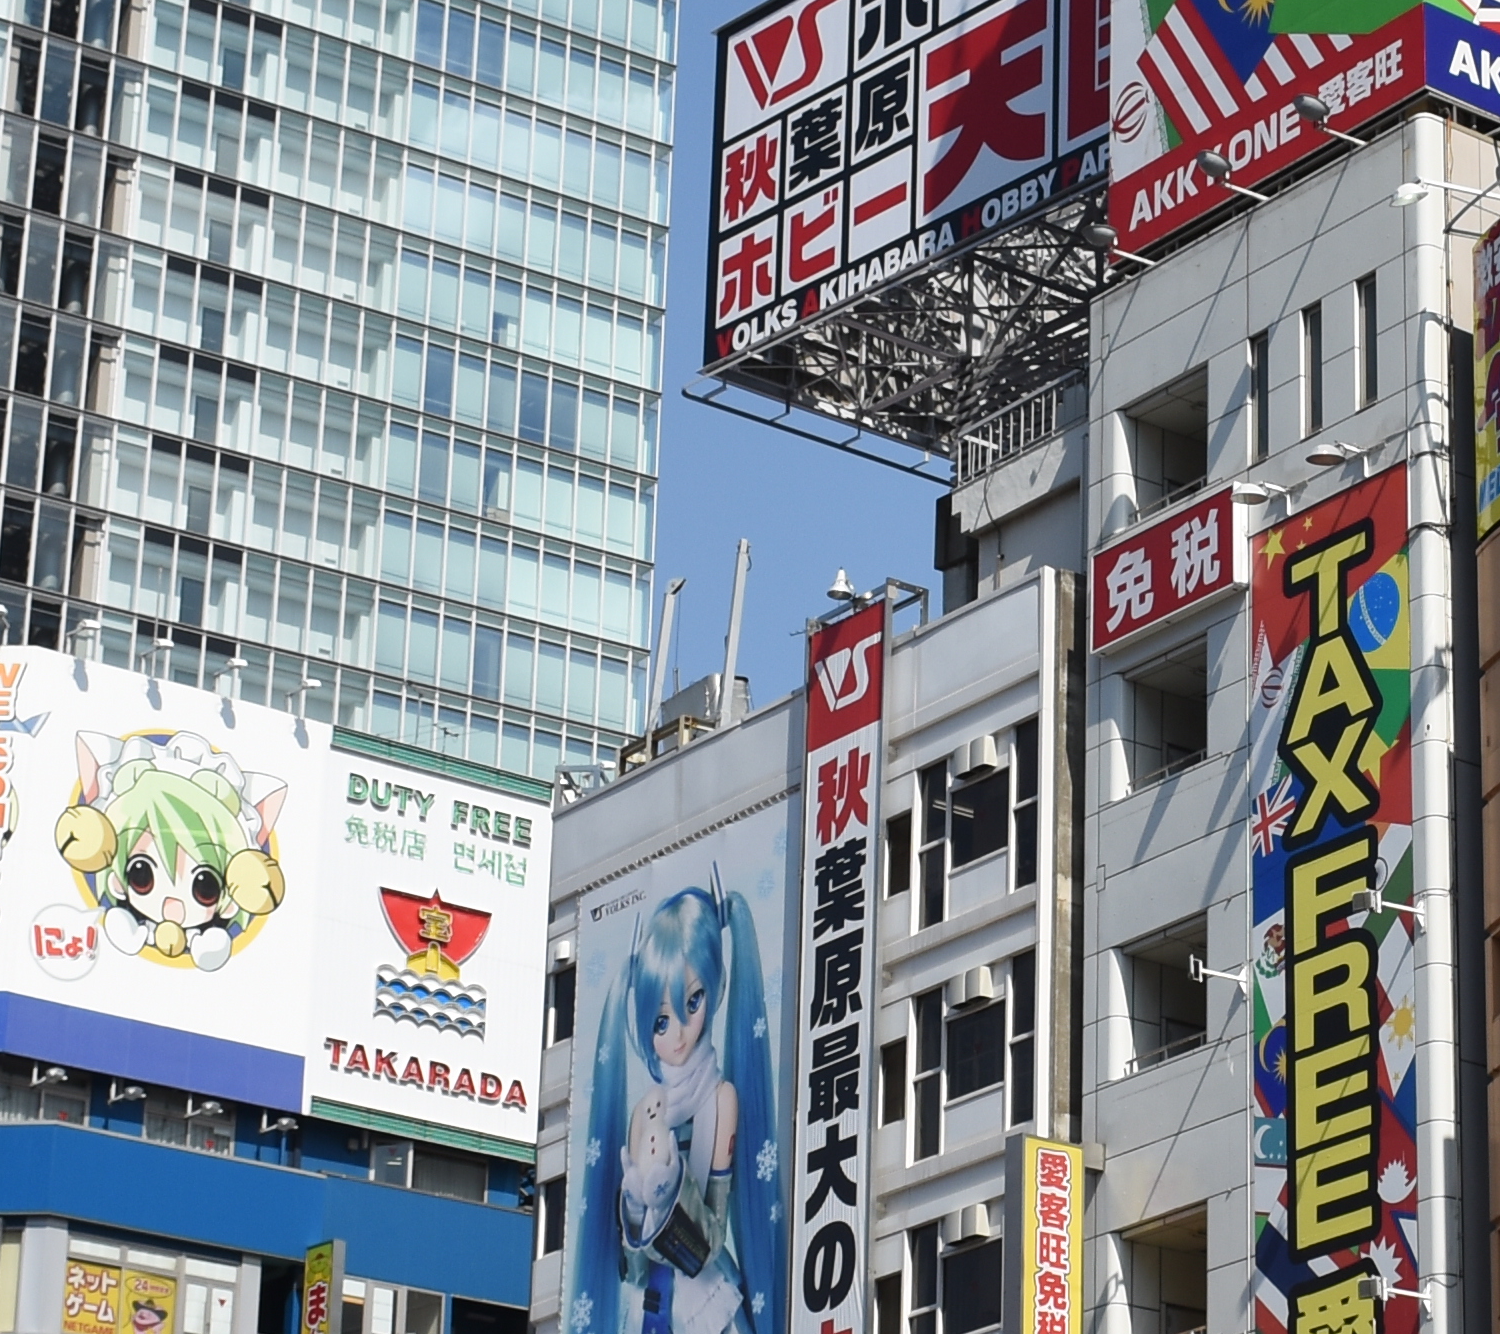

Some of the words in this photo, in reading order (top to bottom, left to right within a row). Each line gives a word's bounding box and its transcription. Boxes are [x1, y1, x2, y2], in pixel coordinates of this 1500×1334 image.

[724, 62, 912, 223] 秋葉原
[1226, 103, 1301, 171] ONE
[1315, 39, 1404, 118] 愛客旺
[716, 299, 798, 357] VOLKS
[801, 222, 955, 314] AKIHABARA
[961, 169, 1054, 236] HOBBY
[719, 179, 908, 319] ホビー
[1104, 507, 1221, 634] 免税
[1290, 530, 1373, 840] TAX
[343, 814, 428, 863] 免税店
[347, 771, 437, 822] DUTY
[451, 798, 533, 849] FREE
[451, 841, 529, 890] 면세점
[33, 921, 99, 966] にょ!
[323, 1035, 529, 1113] TAKARADA
[1293, 847, 1373, 1247] FREE
[65, 1295, 116, 1323] ゲーム
[67, 1266, 118, 1294] ネット
